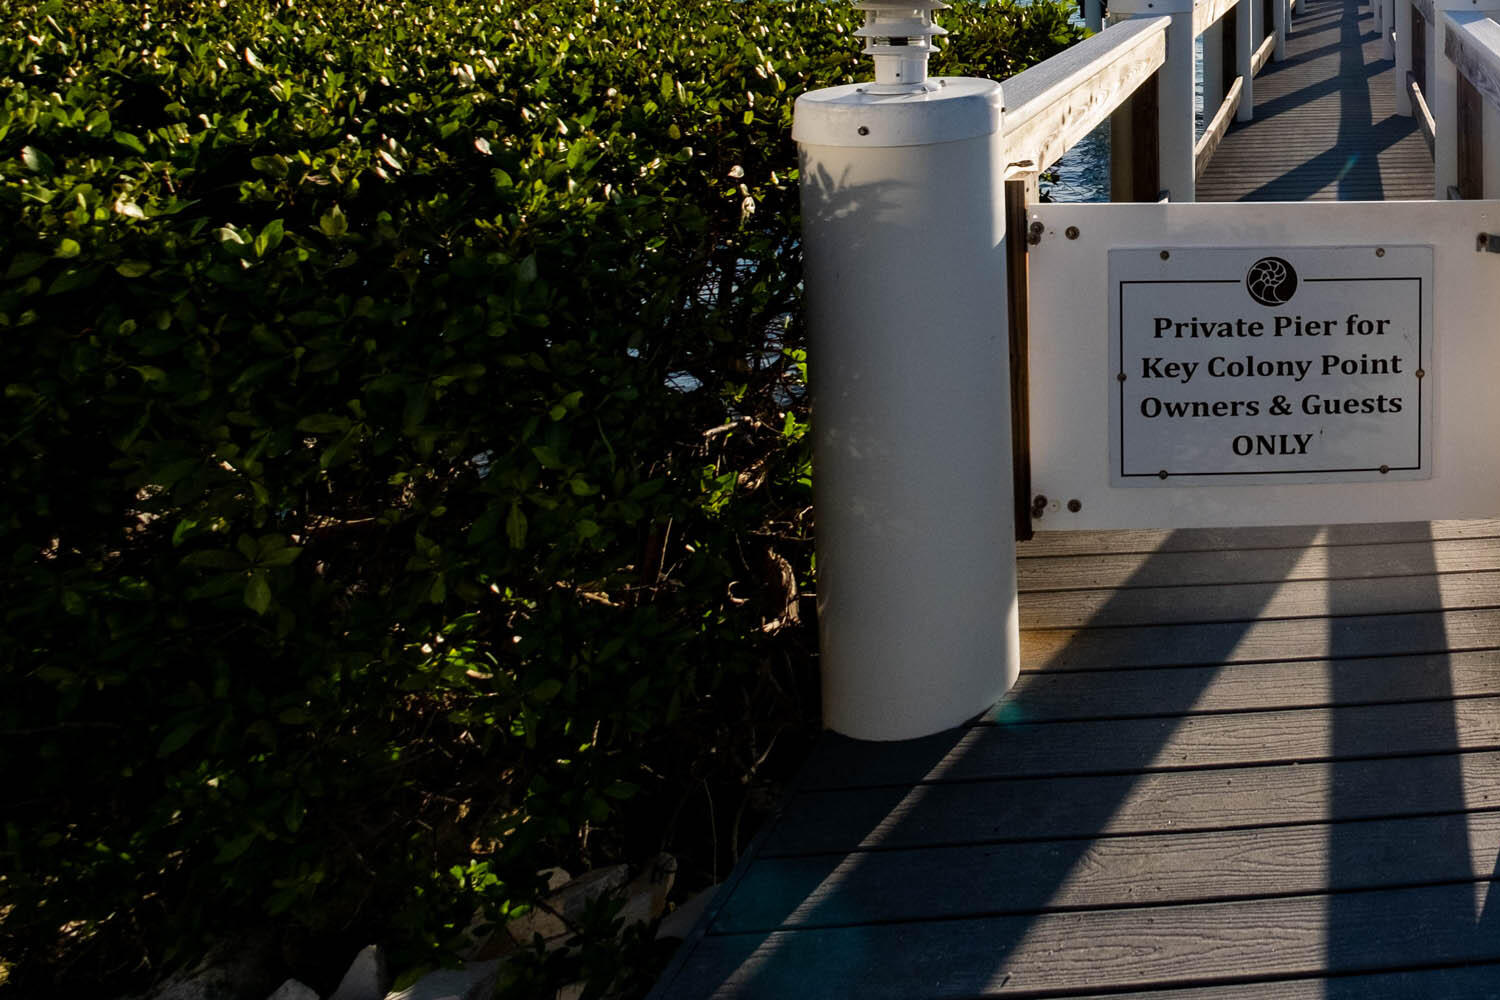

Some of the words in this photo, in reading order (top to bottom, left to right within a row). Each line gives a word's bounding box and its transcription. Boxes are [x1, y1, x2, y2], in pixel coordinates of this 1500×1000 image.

[1153, 316, 1265, 339] Private
[1273, 315, 1338, 337] Pier
[1345, 313, 1391, 336] for
[1141, 357, 1200, 385] Key
[1207, 355, 1313, 382] Colony
[1321, 353, 1403, 376] Point
[1140, 396, 1260, 419] Owners
[1268, 394, 1293, 417] &
[1301, 394, 1403, 416] Guests
[1232, 433, 1314, 457] ONLY
